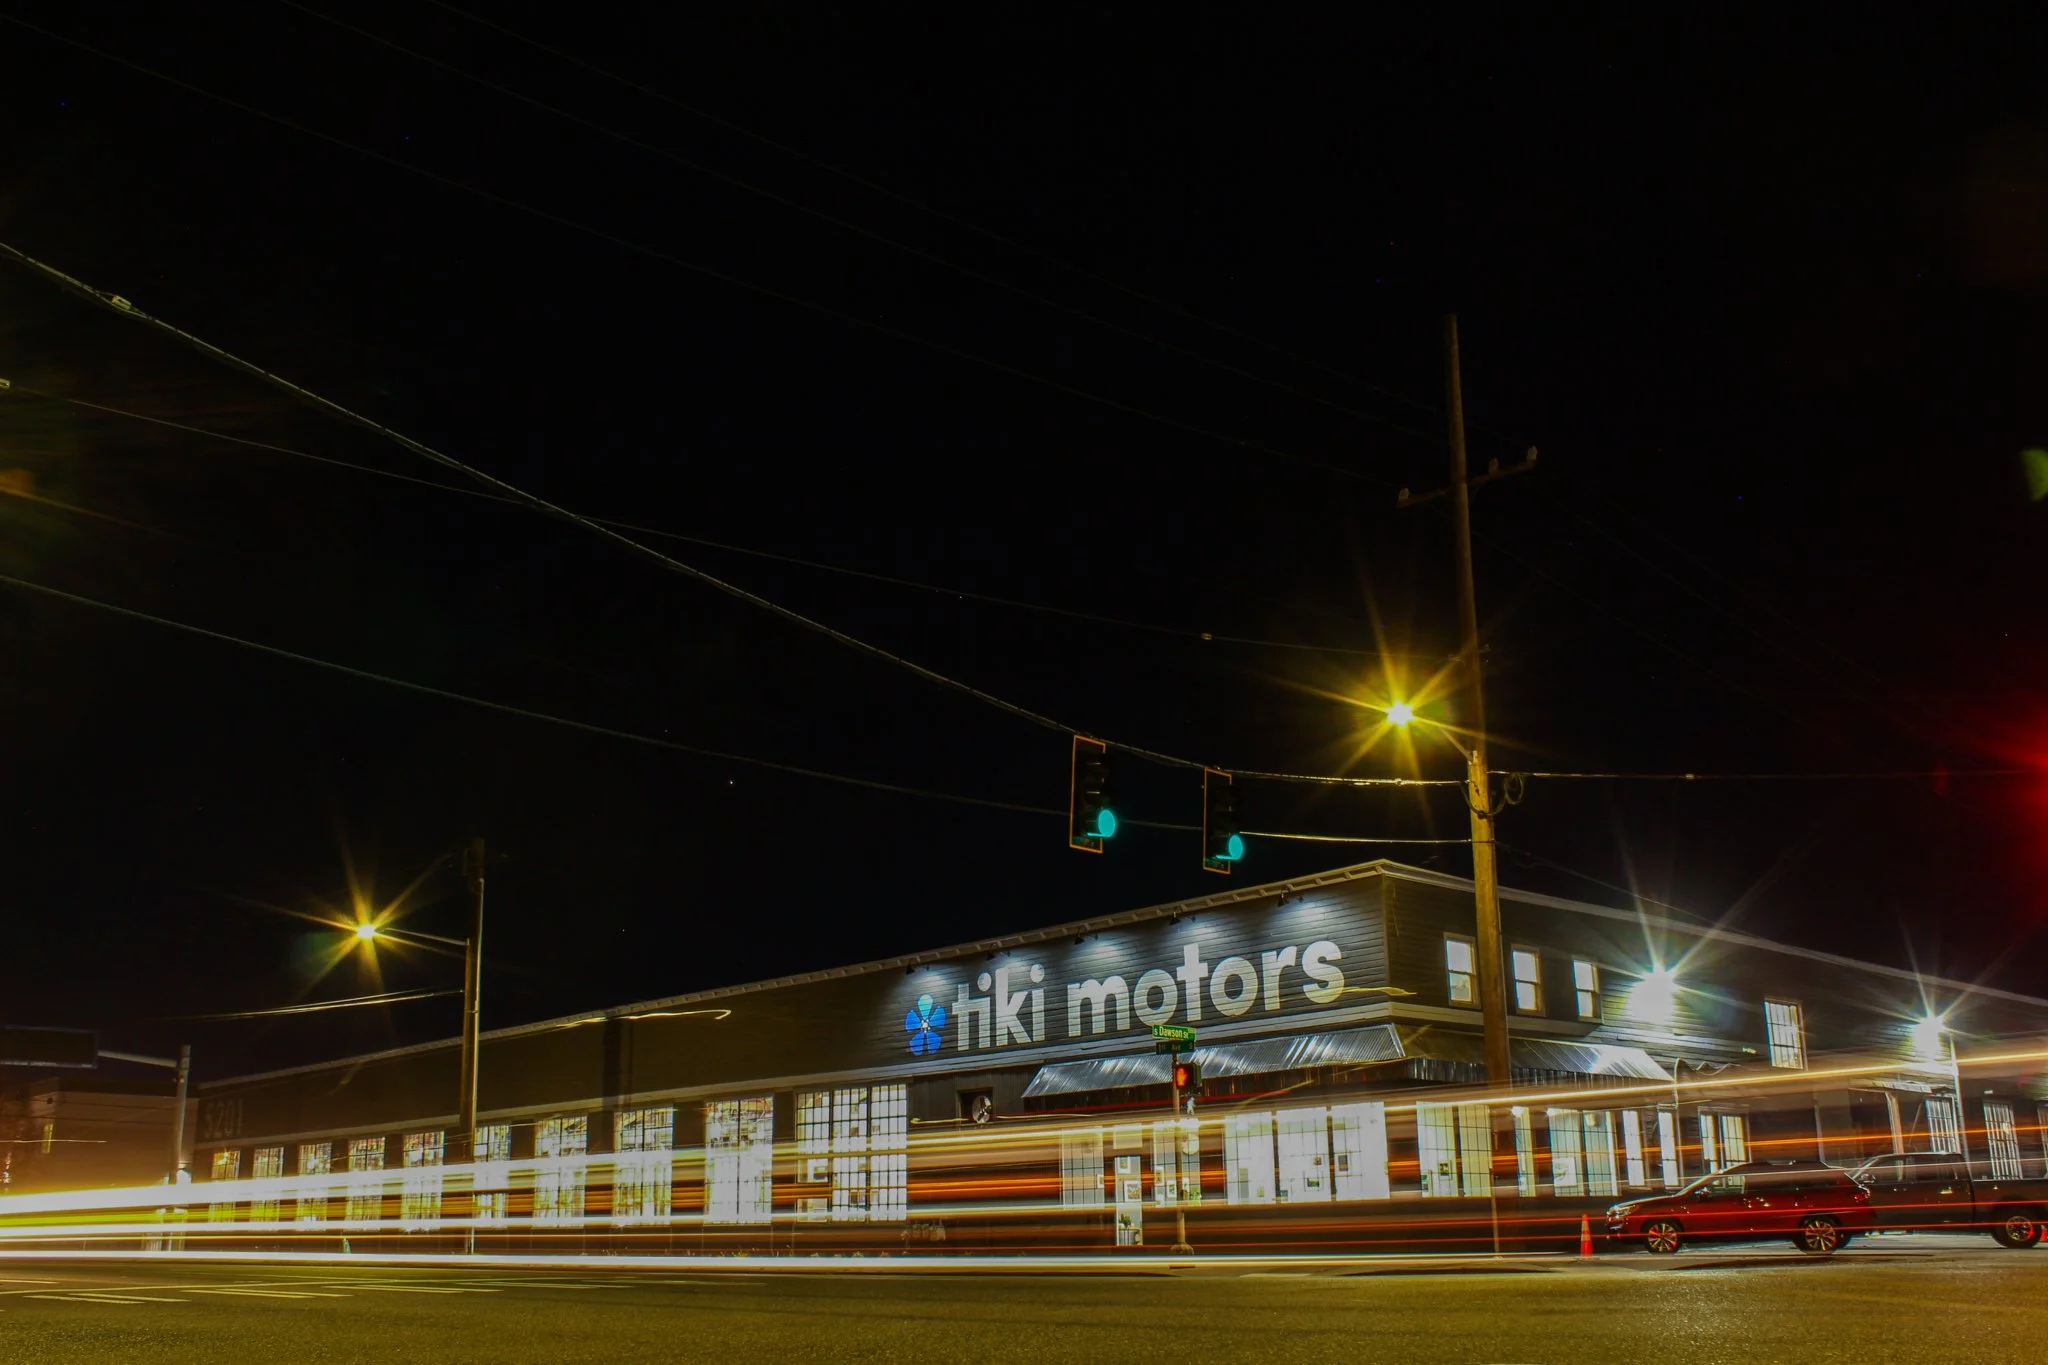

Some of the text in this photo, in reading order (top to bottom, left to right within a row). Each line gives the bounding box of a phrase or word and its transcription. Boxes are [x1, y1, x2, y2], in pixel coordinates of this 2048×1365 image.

[951, 941, 1345, 1051] tiki motors
[1159, 1026, 1183, 1038] Dawson
[204, 1097, 243, 1140] 5201
